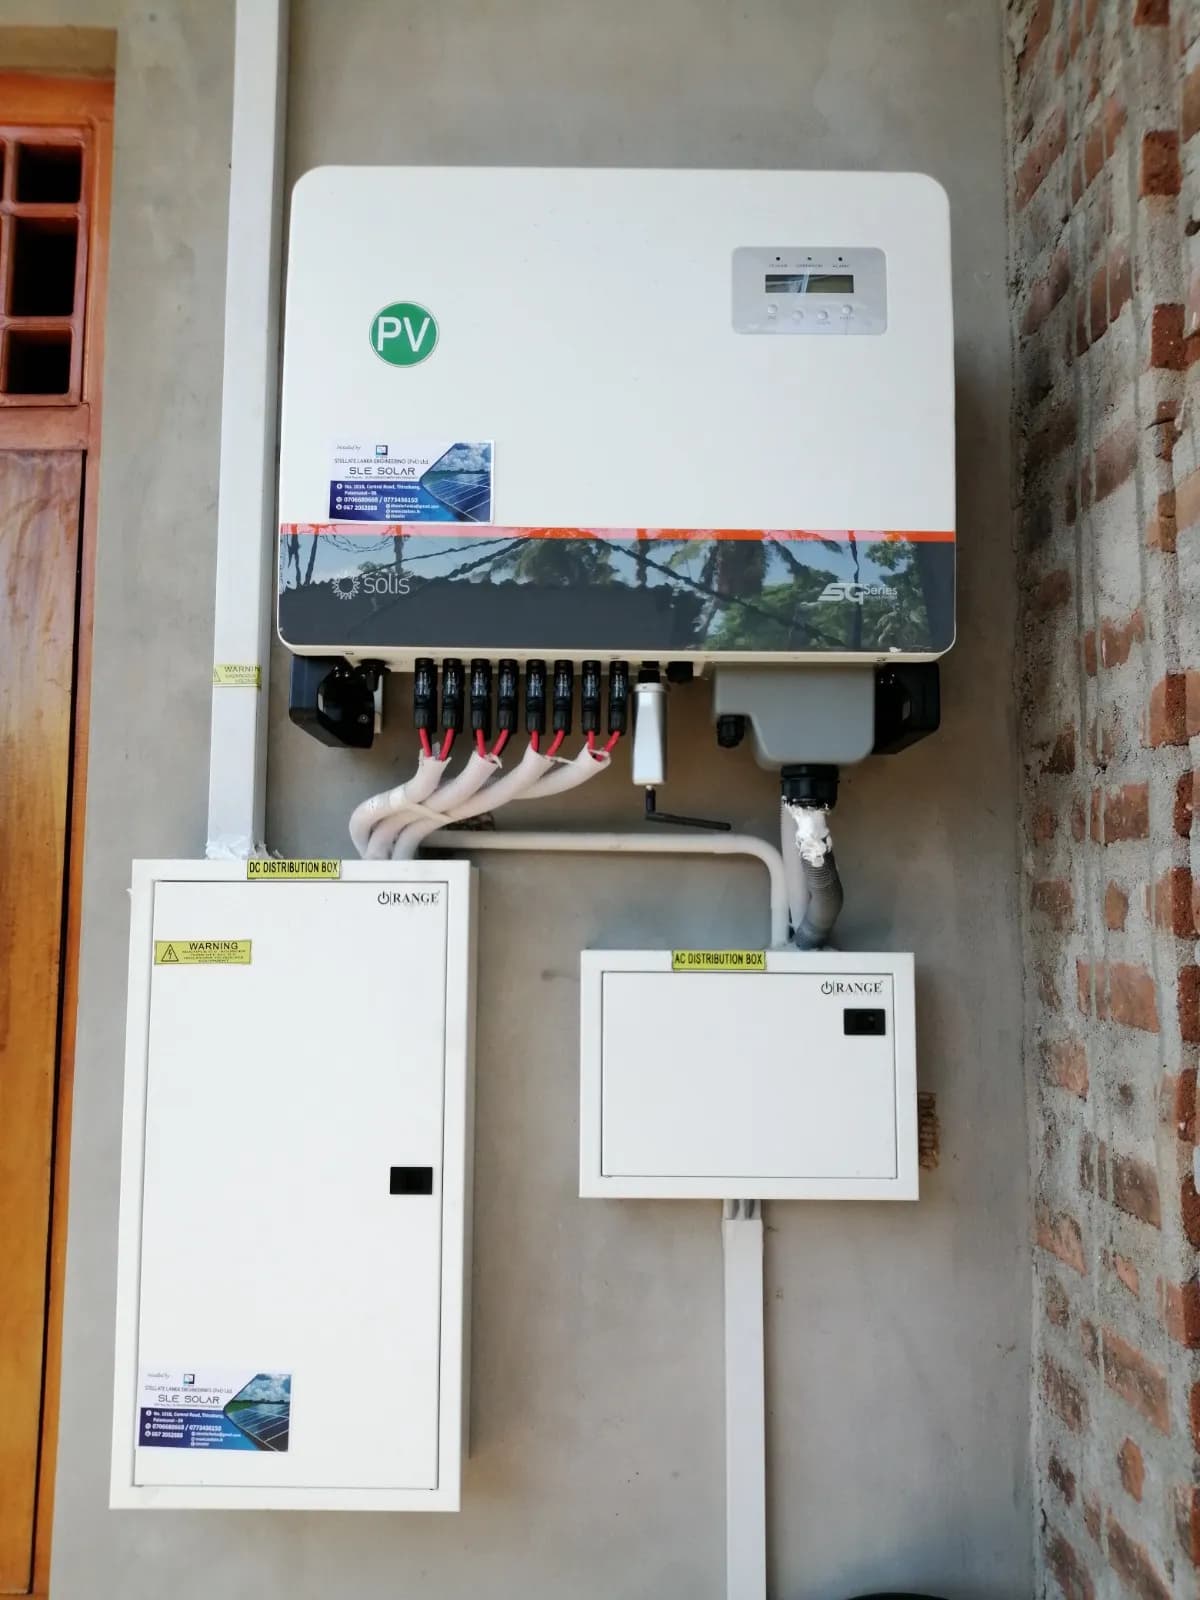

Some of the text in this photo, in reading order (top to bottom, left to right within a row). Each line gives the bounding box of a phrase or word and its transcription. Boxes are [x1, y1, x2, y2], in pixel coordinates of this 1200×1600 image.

[377, 316, 431, 352] PV
[349, 466, 416, 476] SLE SOLAR
[863, 584, 898, 596] Series
[250, 862, 338, 872] DC DISTRIBUTION BOX
[674, 952, 762, 964] AC DISTRIBUTION BOX
[158, 1394, 220, 1404] SLE SOLAR
